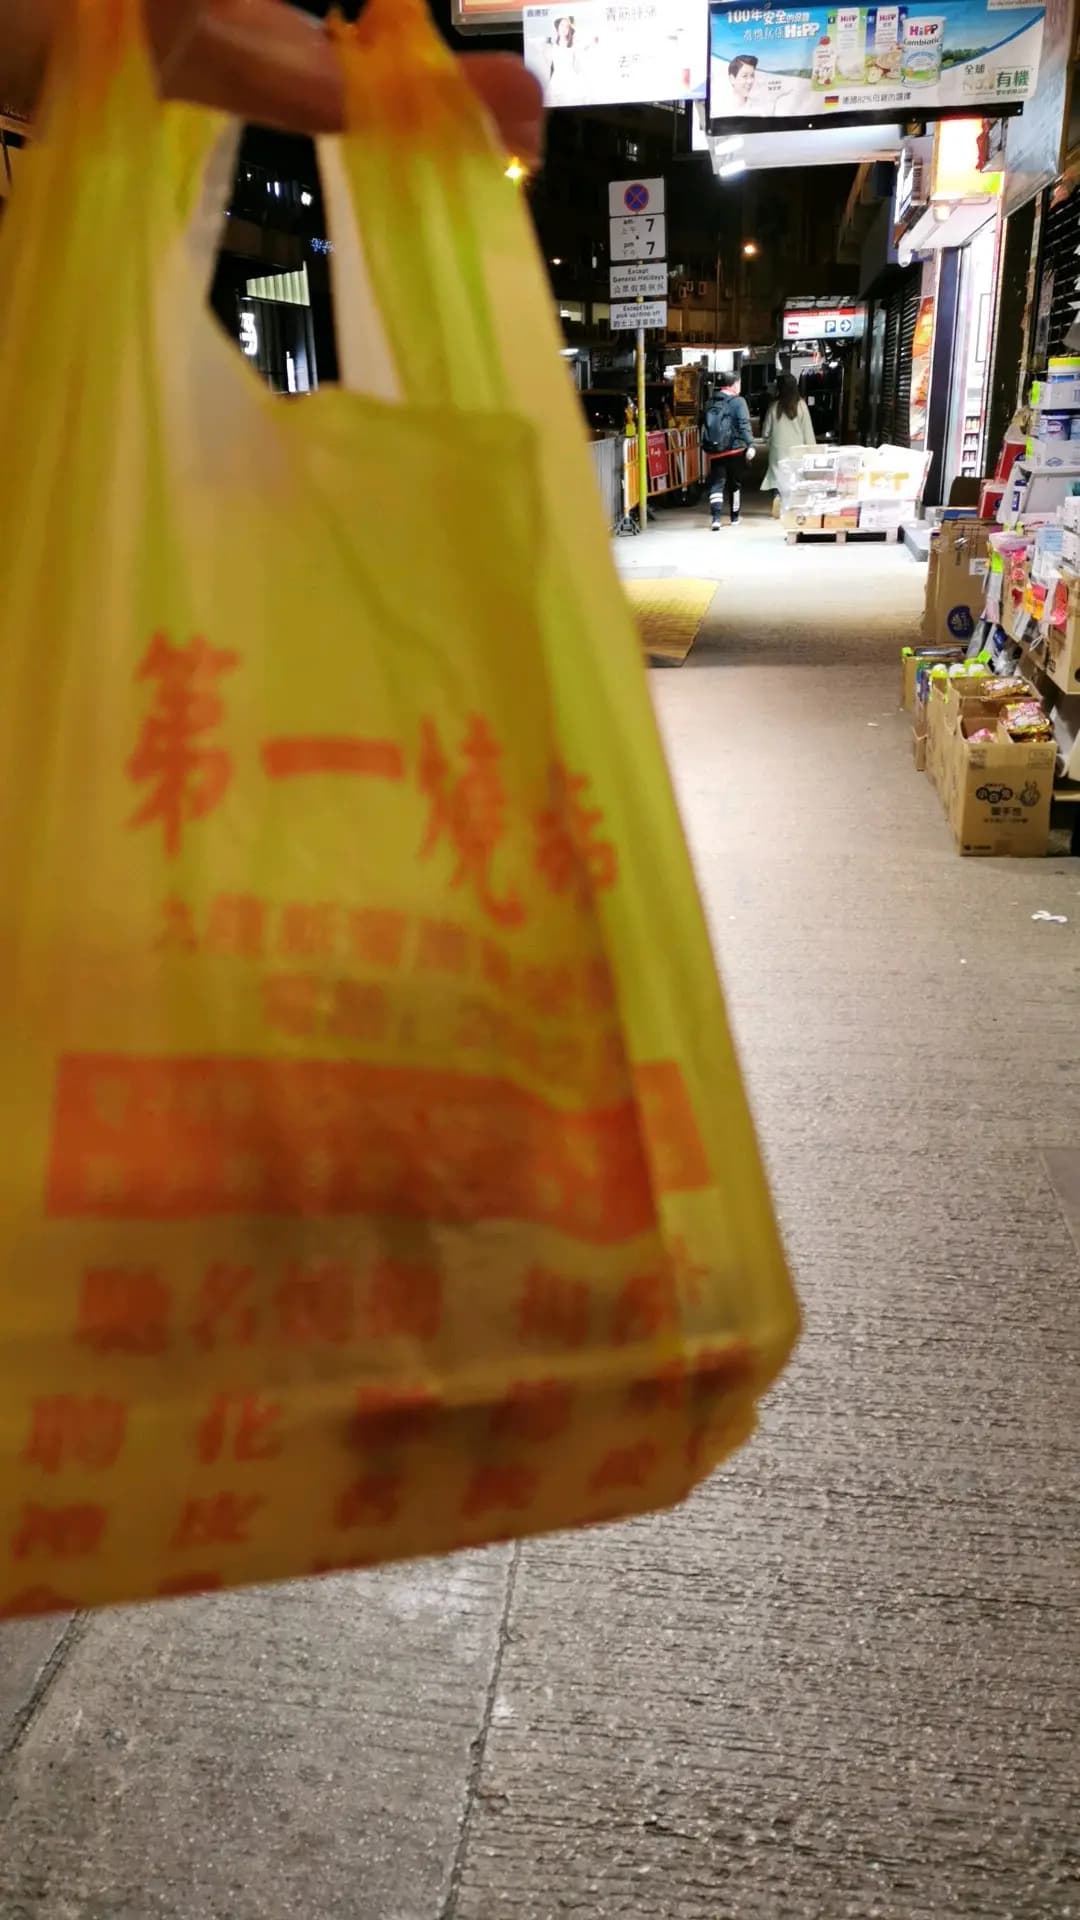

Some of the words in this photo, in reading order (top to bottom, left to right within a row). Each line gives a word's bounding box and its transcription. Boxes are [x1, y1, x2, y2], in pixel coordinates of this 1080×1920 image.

[909, 23, 939, 36] HiPP
[996, 69, 1030, 88] 有機
[645, 218, 655, 232] 7
[646, 241, 655, 255] 7
